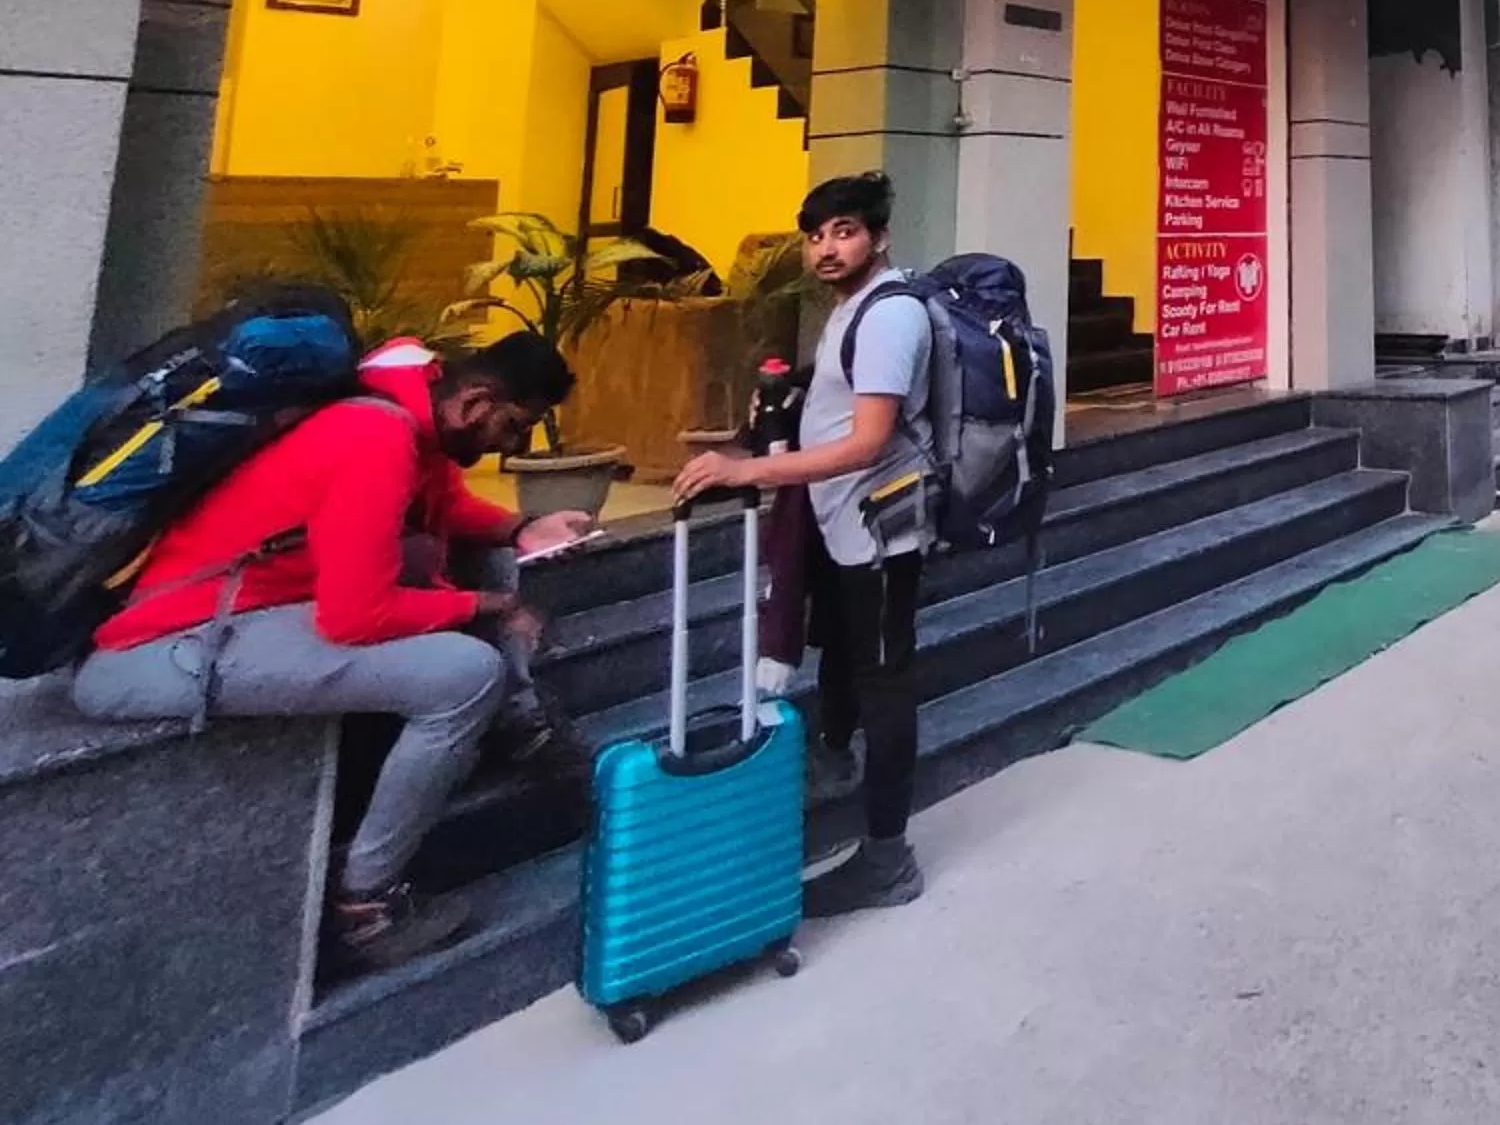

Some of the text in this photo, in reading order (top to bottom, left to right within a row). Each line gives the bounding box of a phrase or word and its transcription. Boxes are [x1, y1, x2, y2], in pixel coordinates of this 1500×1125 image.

[1165, 193, 1240, 209] Kitchen Service
[1164, 212, 1203, 230] Parking
[1166, 242, 1228, 260] ACTIVITY
[1162, 284, 1207, 301] Camping
[1200, 300, 1217, 315] For
[1161, 323, 1181, 338] Car
